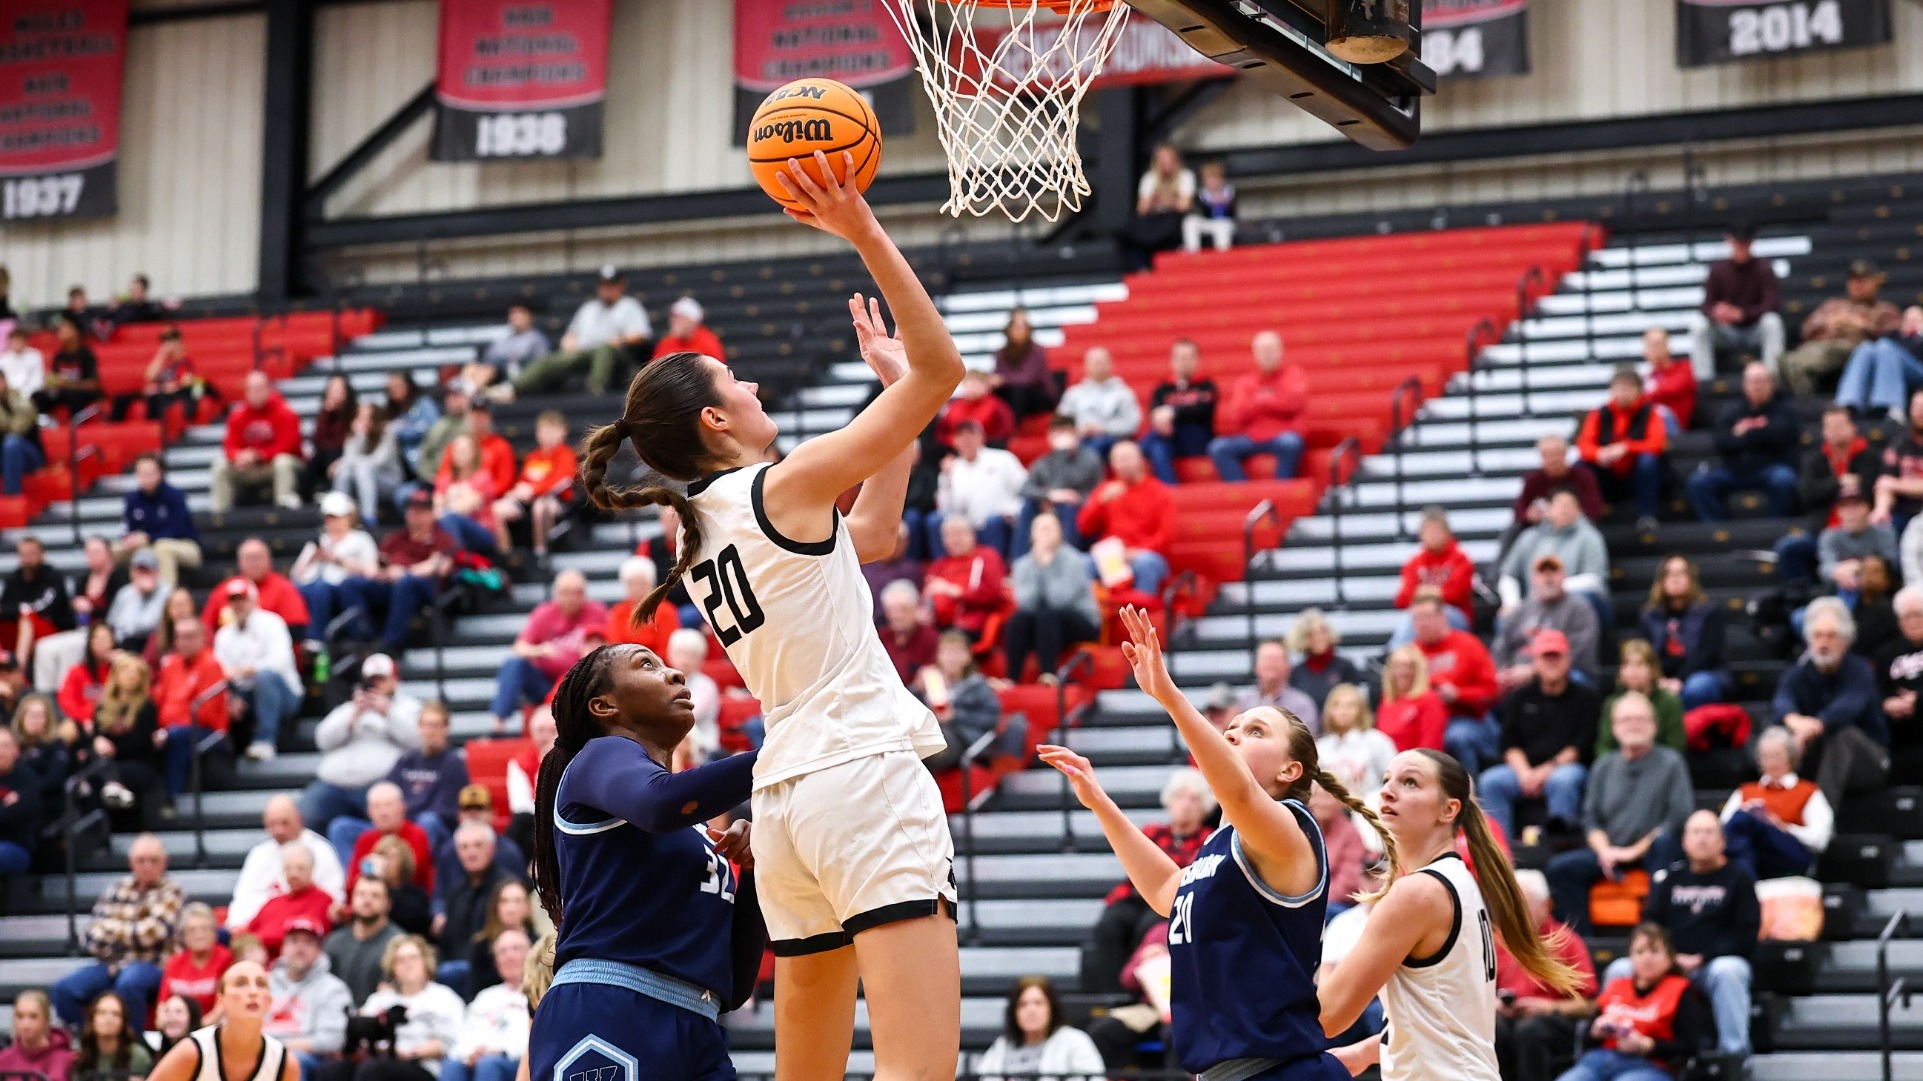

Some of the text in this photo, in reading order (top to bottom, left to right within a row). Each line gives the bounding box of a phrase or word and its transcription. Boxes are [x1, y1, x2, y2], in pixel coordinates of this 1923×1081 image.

[1421, 27, 1484, 76] 84
[1728, 0, 1843, 55] 2014
[753, 118, 833, 143] Wilson
[2, 172, 85, 220] 1937
[690, 543, 765, 648] 20
[700, 842, 735, 905] 32
[1168, 891, 1194, 945] 20
[1477, 908, 1495, 983] 10
